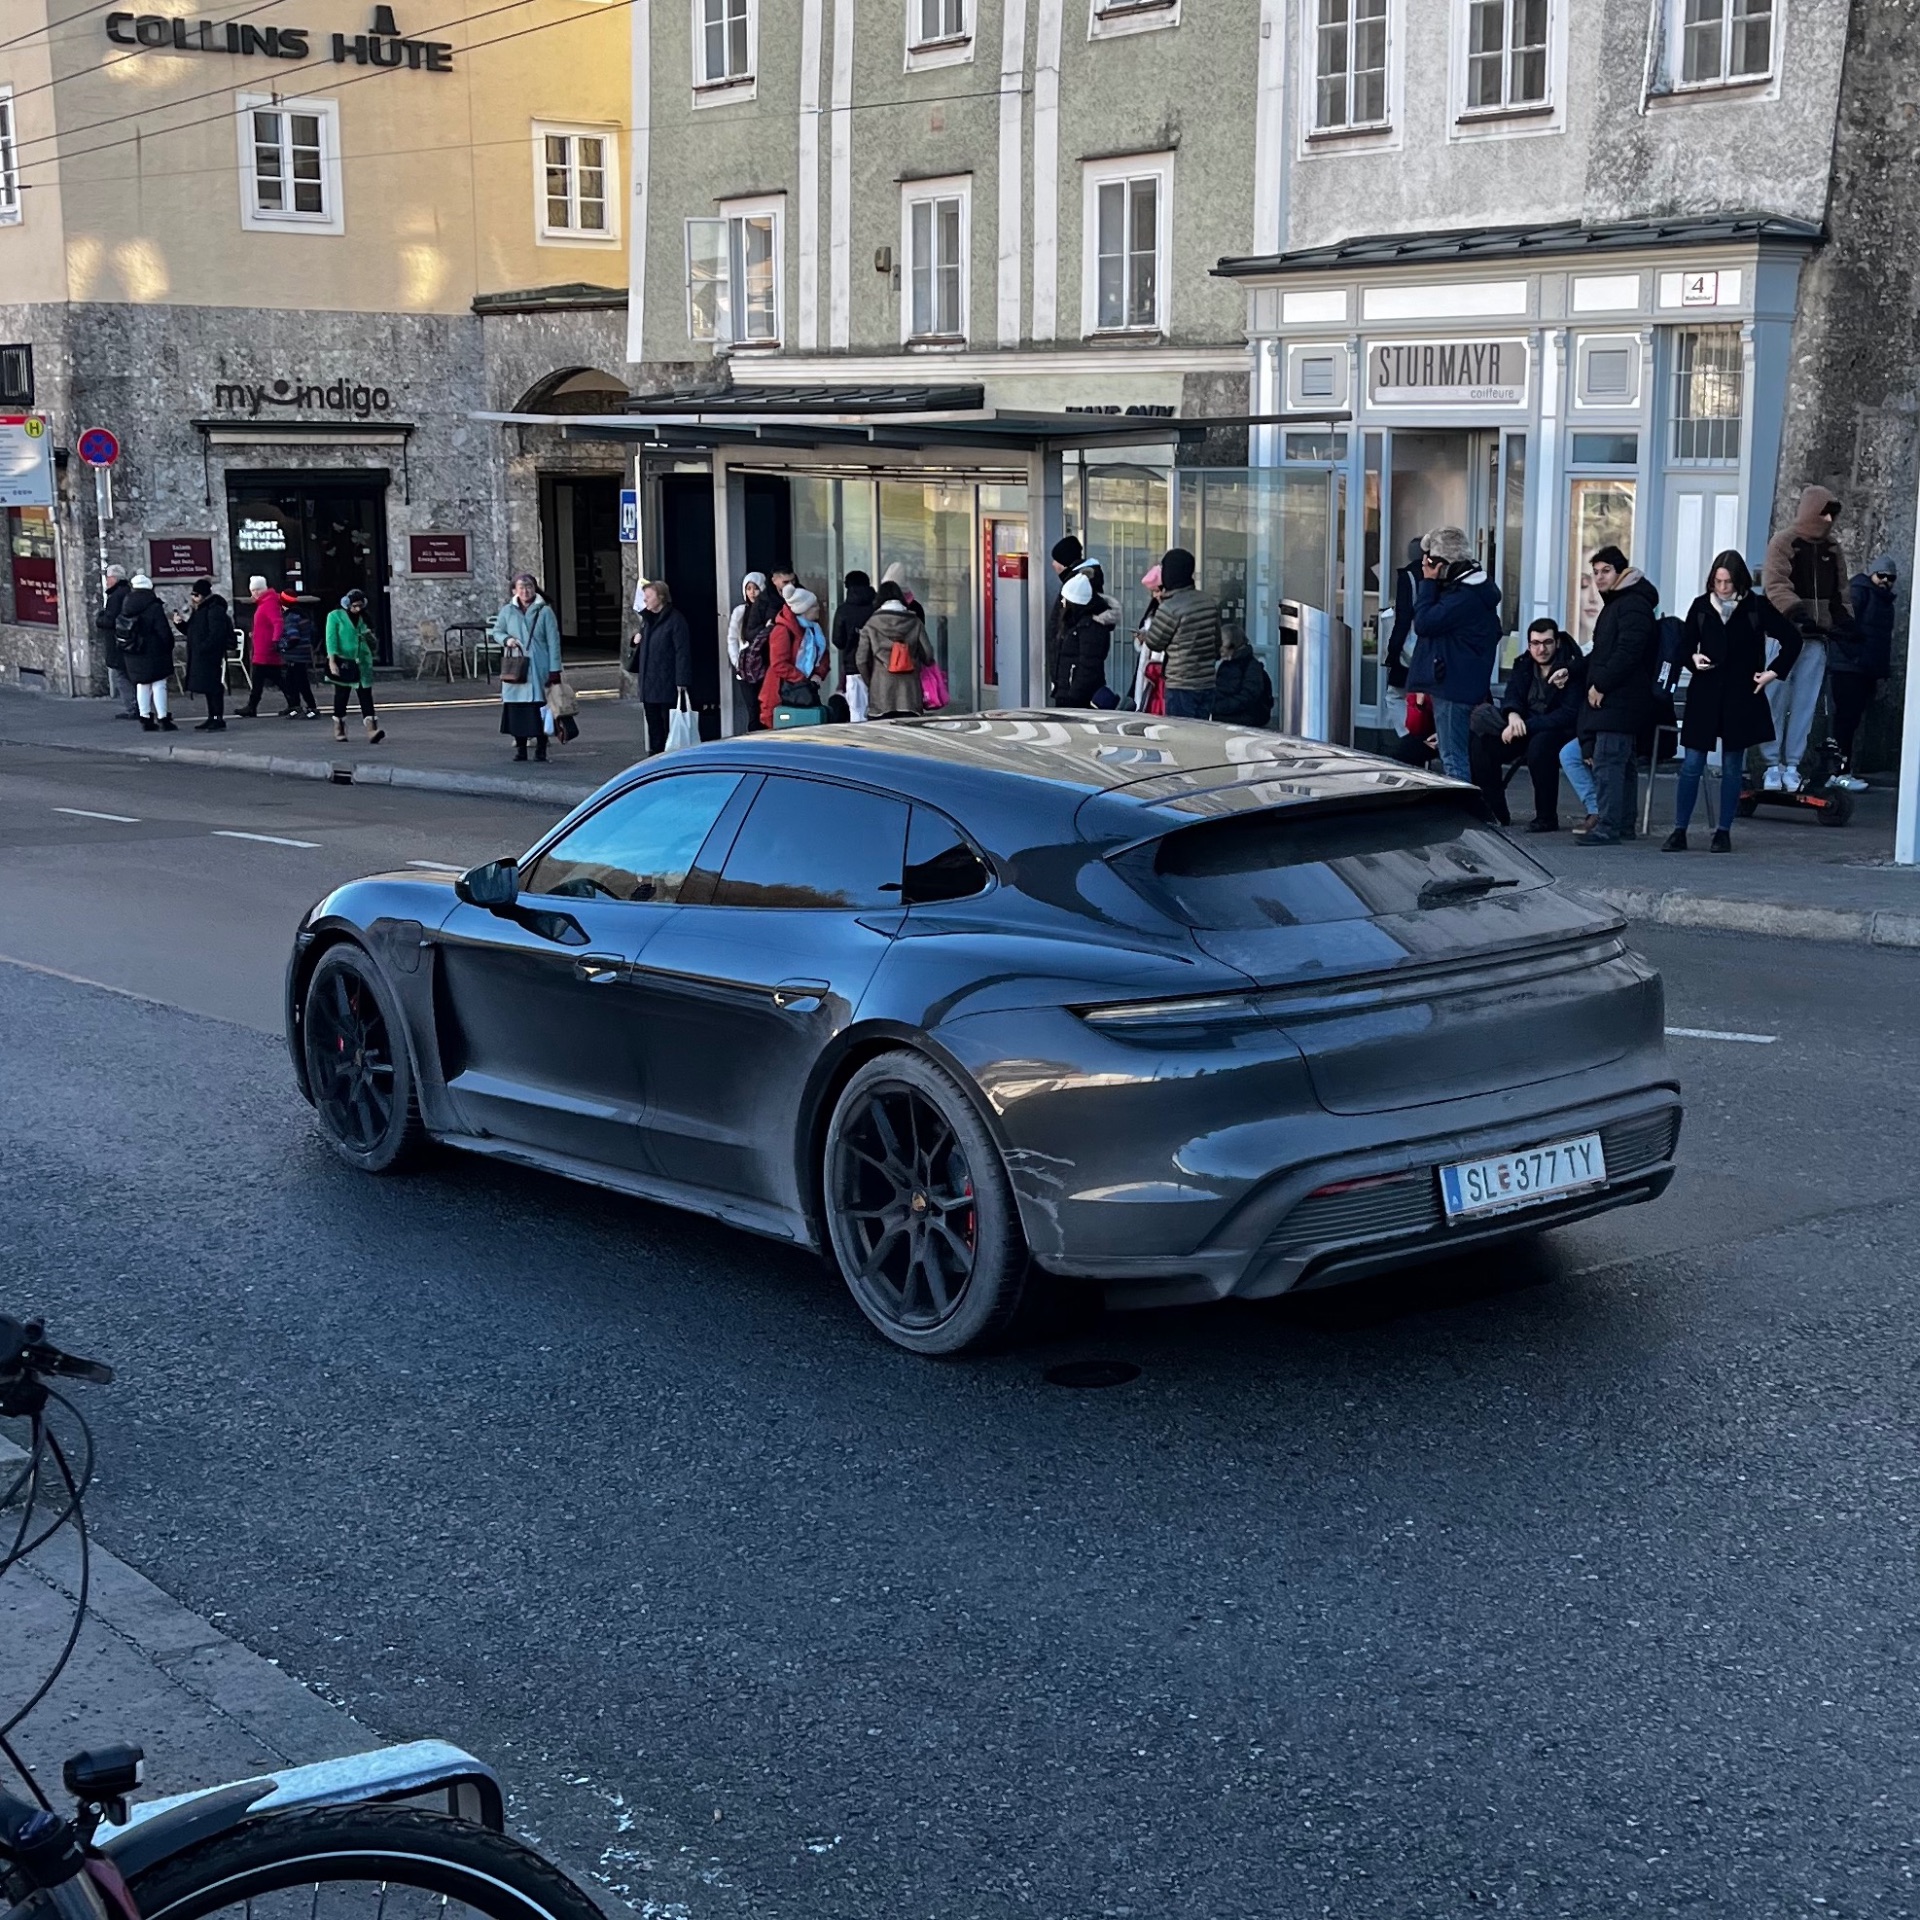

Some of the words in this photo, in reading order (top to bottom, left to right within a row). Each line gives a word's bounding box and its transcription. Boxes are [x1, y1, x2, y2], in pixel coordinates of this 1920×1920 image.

[106, 12, 309, 59] COLLINS
[1691, 276, 1704, 294] 4
[1379, 343, 1500, 387] STURMAYR
[216, 384, 265, 416] my
[296, 378, 390, 418] indigo
[1470, 388, 1515, 399] coiffeure
[29, 421, 40, 435] H
[244, 518, 278, 530] Super
[238, 529, 285, 540] Natural
[239, 540, 286, 551] Kitchen
[1467, 1166, 1498, 1203] SL
[1515, 1150, 1557, 1191] 377
[1564, 1143, 1592, 1179] TY
